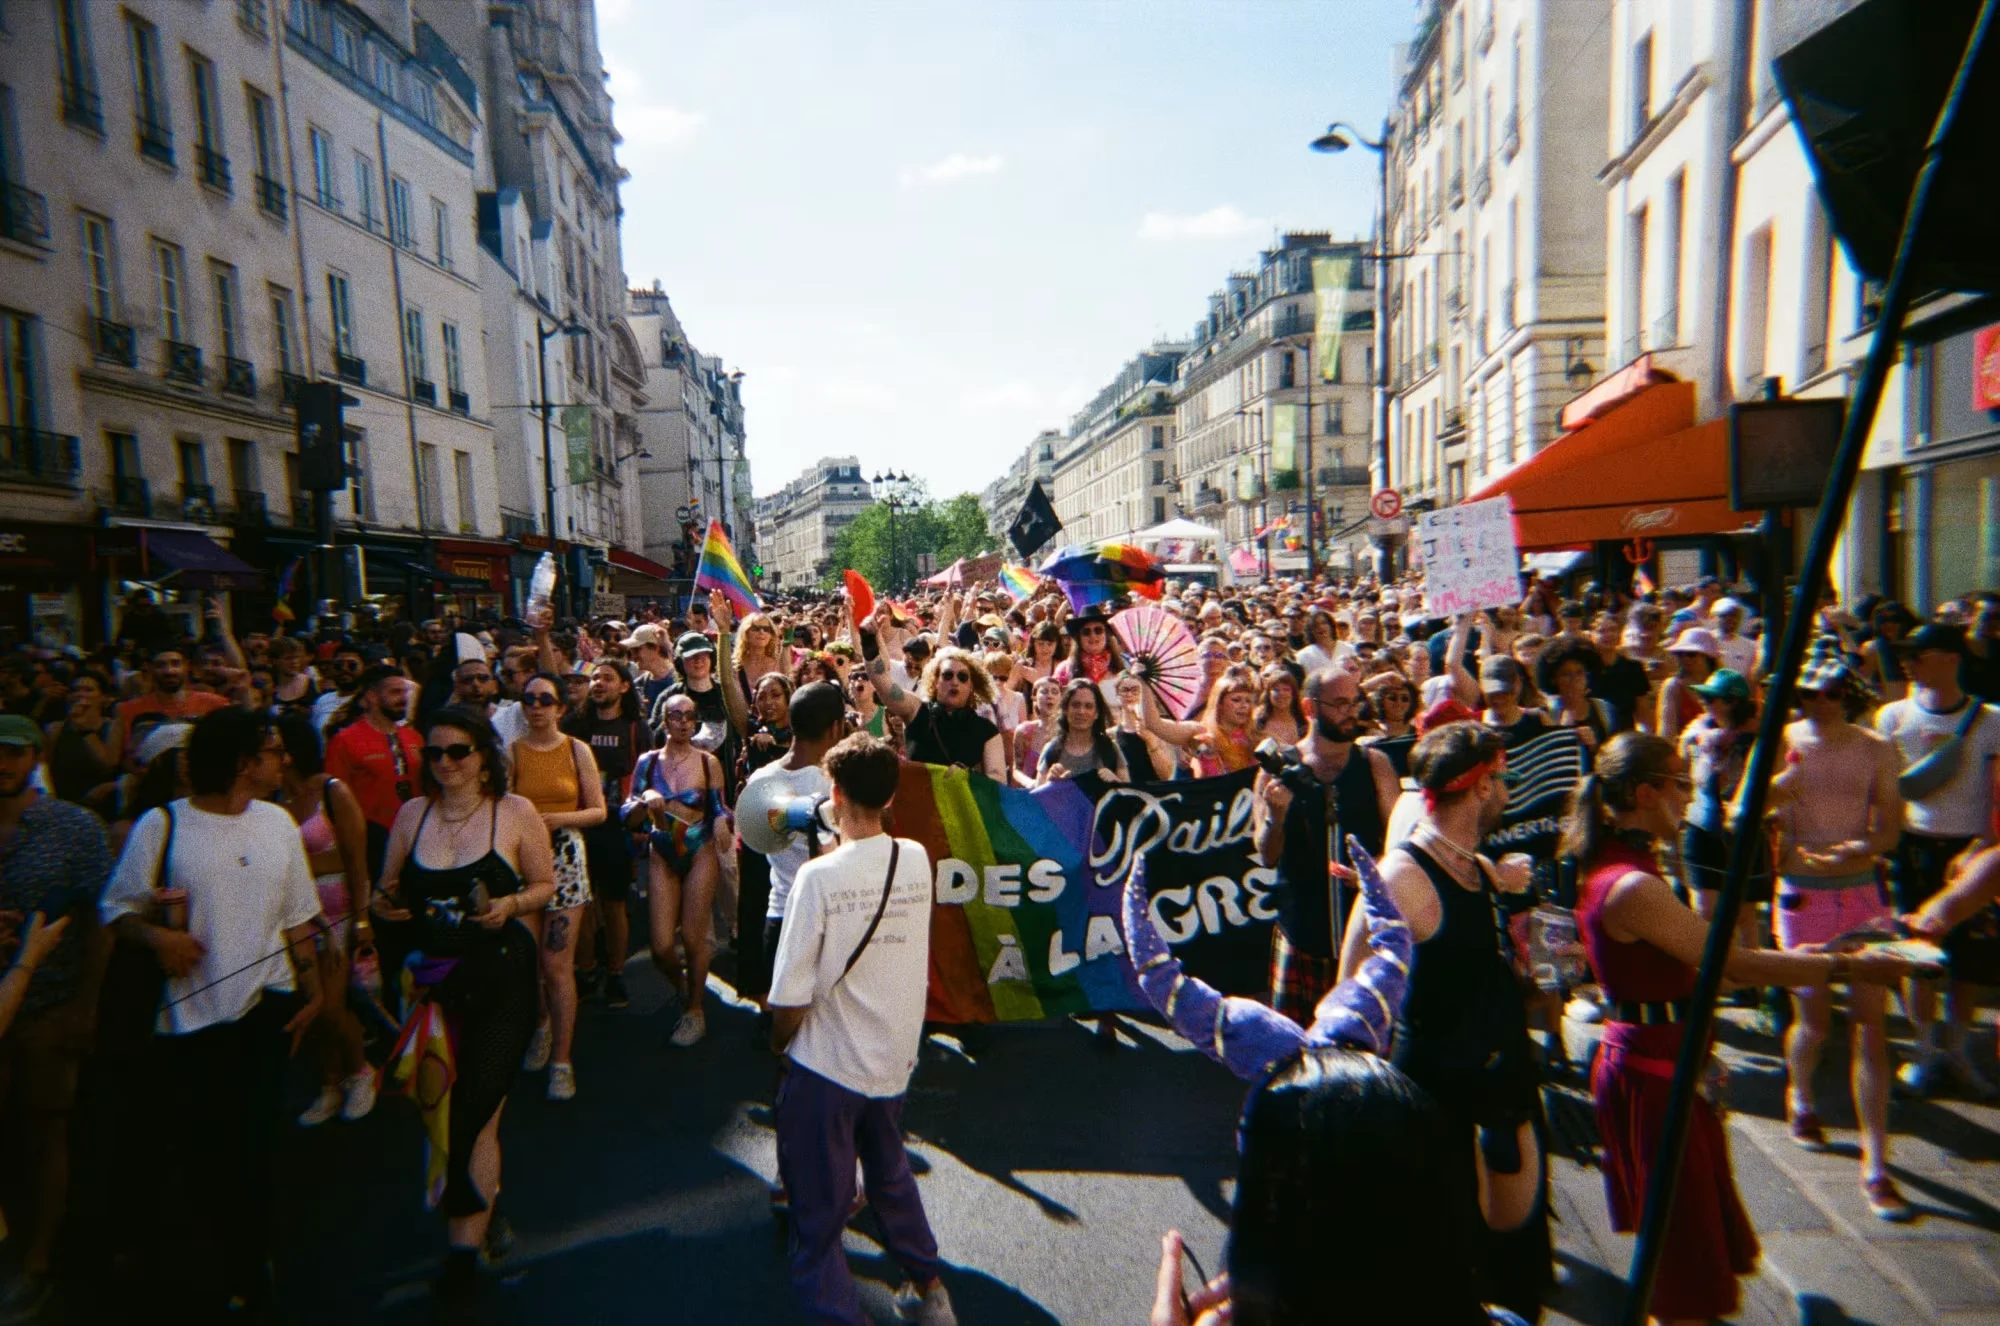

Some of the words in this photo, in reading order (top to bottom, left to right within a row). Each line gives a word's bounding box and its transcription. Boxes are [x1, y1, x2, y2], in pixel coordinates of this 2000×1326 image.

[935, 857, 1067, 907] DES
[987, 933, 1031, 986] À
[1048, 915, 1125, 977] LA
[1148, 853, 1280, 945] GRÈ
